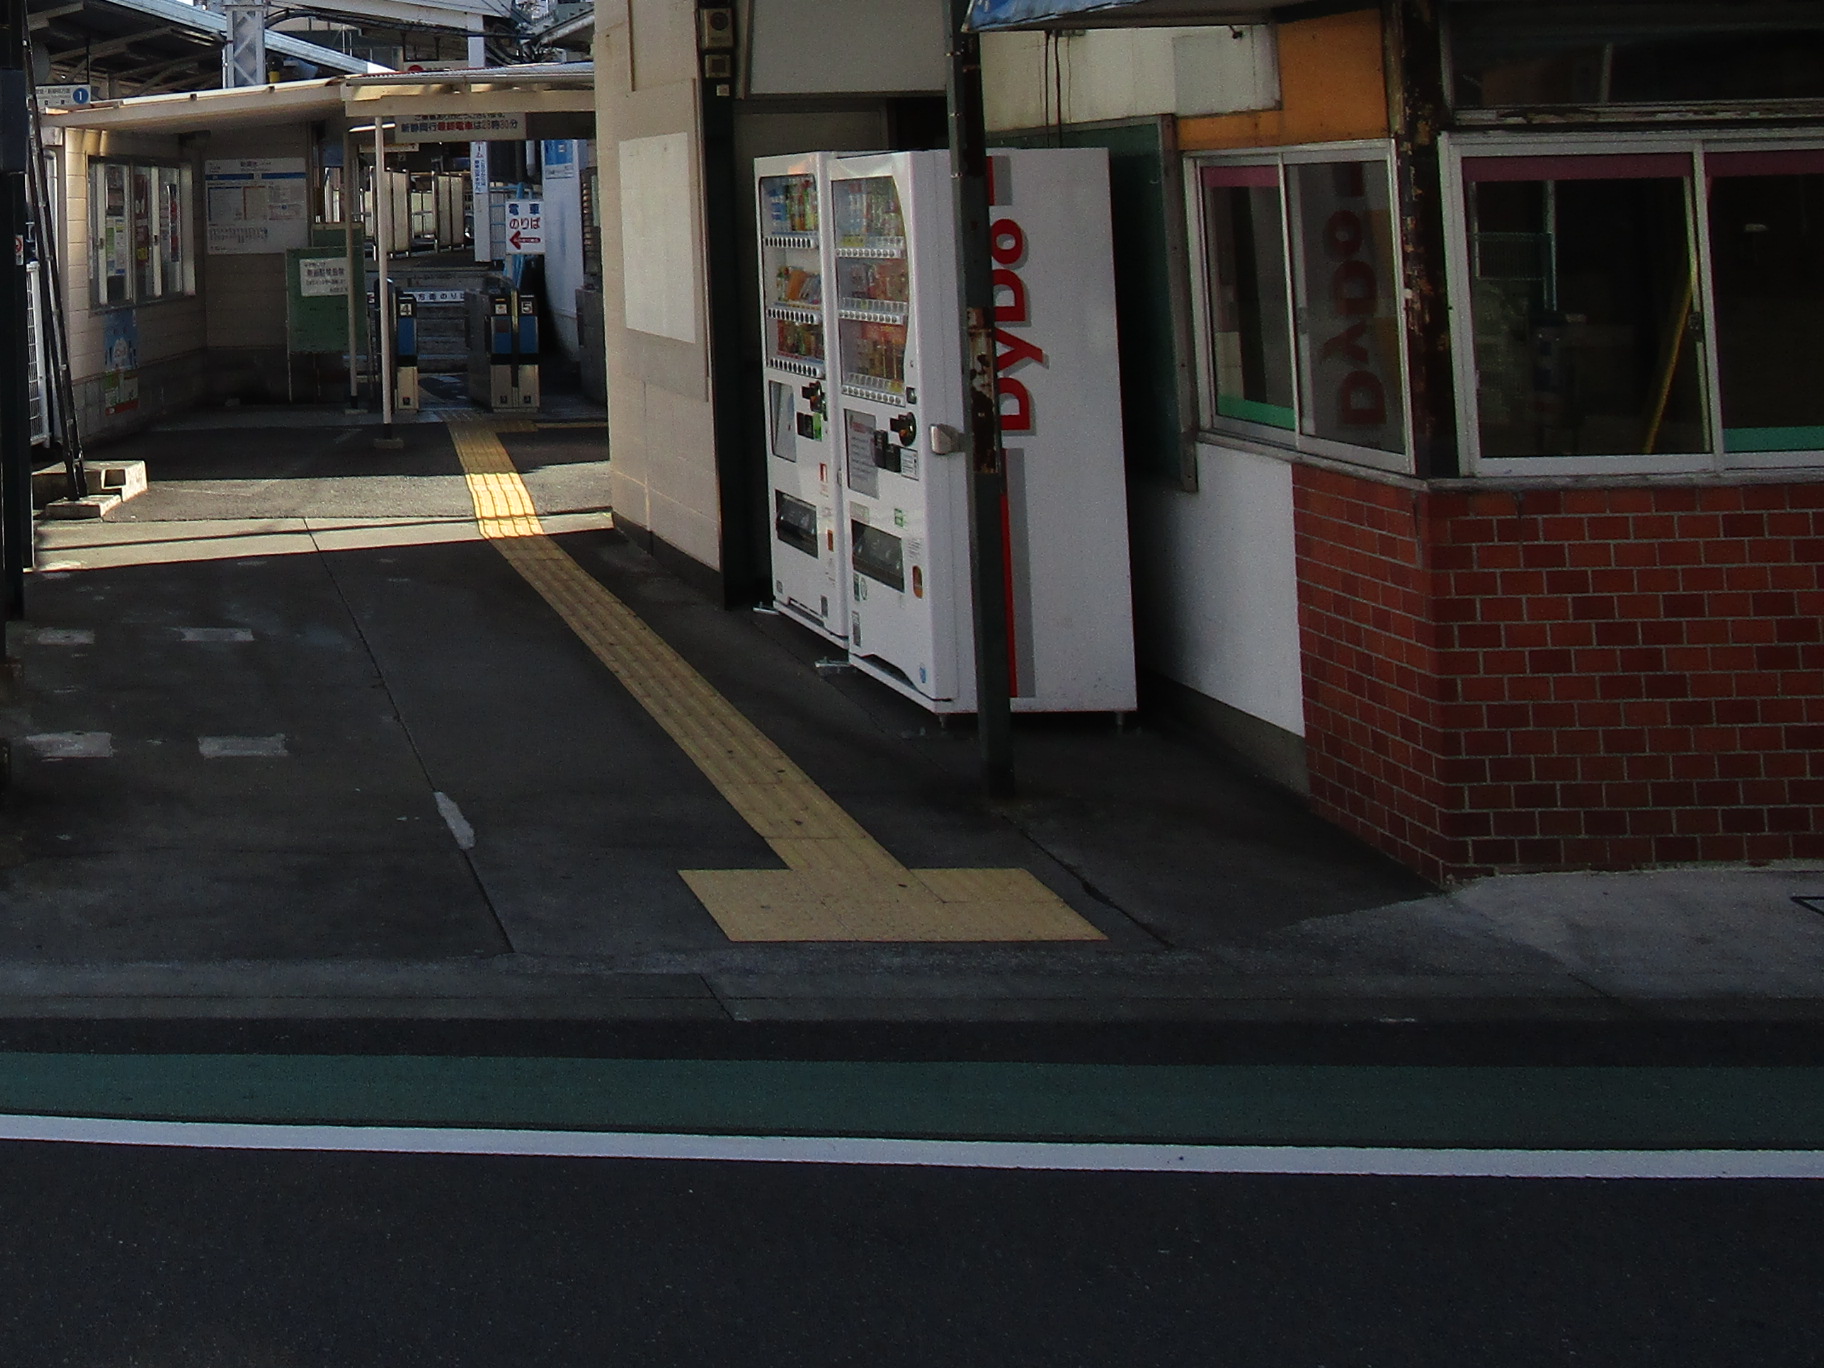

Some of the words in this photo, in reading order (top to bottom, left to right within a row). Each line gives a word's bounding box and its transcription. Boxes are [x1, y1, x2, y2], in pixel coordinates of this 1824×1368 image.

[509, 217, 541, 230] のりば
[400, 304, 411, 315] 4
[522, 302, 533, 312] 5
